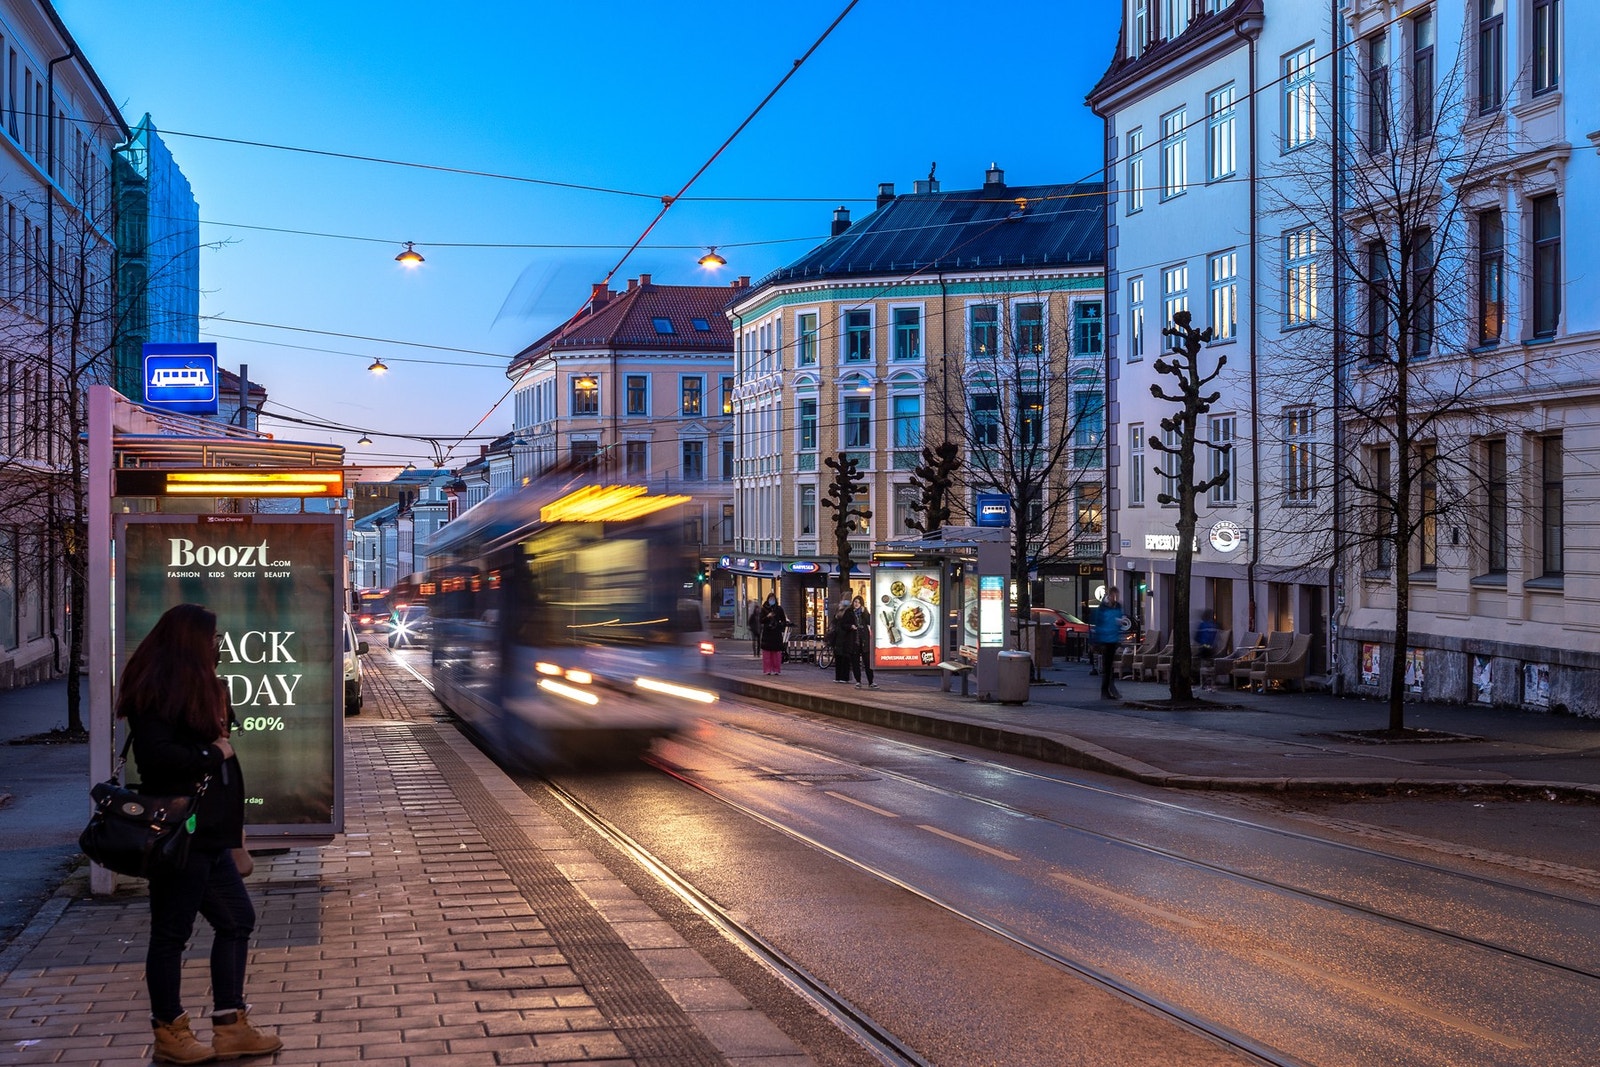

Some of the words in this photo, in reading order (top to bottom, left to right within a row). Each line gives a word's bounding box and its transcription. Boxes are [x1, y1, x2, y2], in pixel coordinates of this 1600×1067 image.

[218, 631, 297, 664] ACK
[217, 674, 302, 707] DAY
[243, 717, 285, 731] 60%
[249, 797, 264, 805] dag
